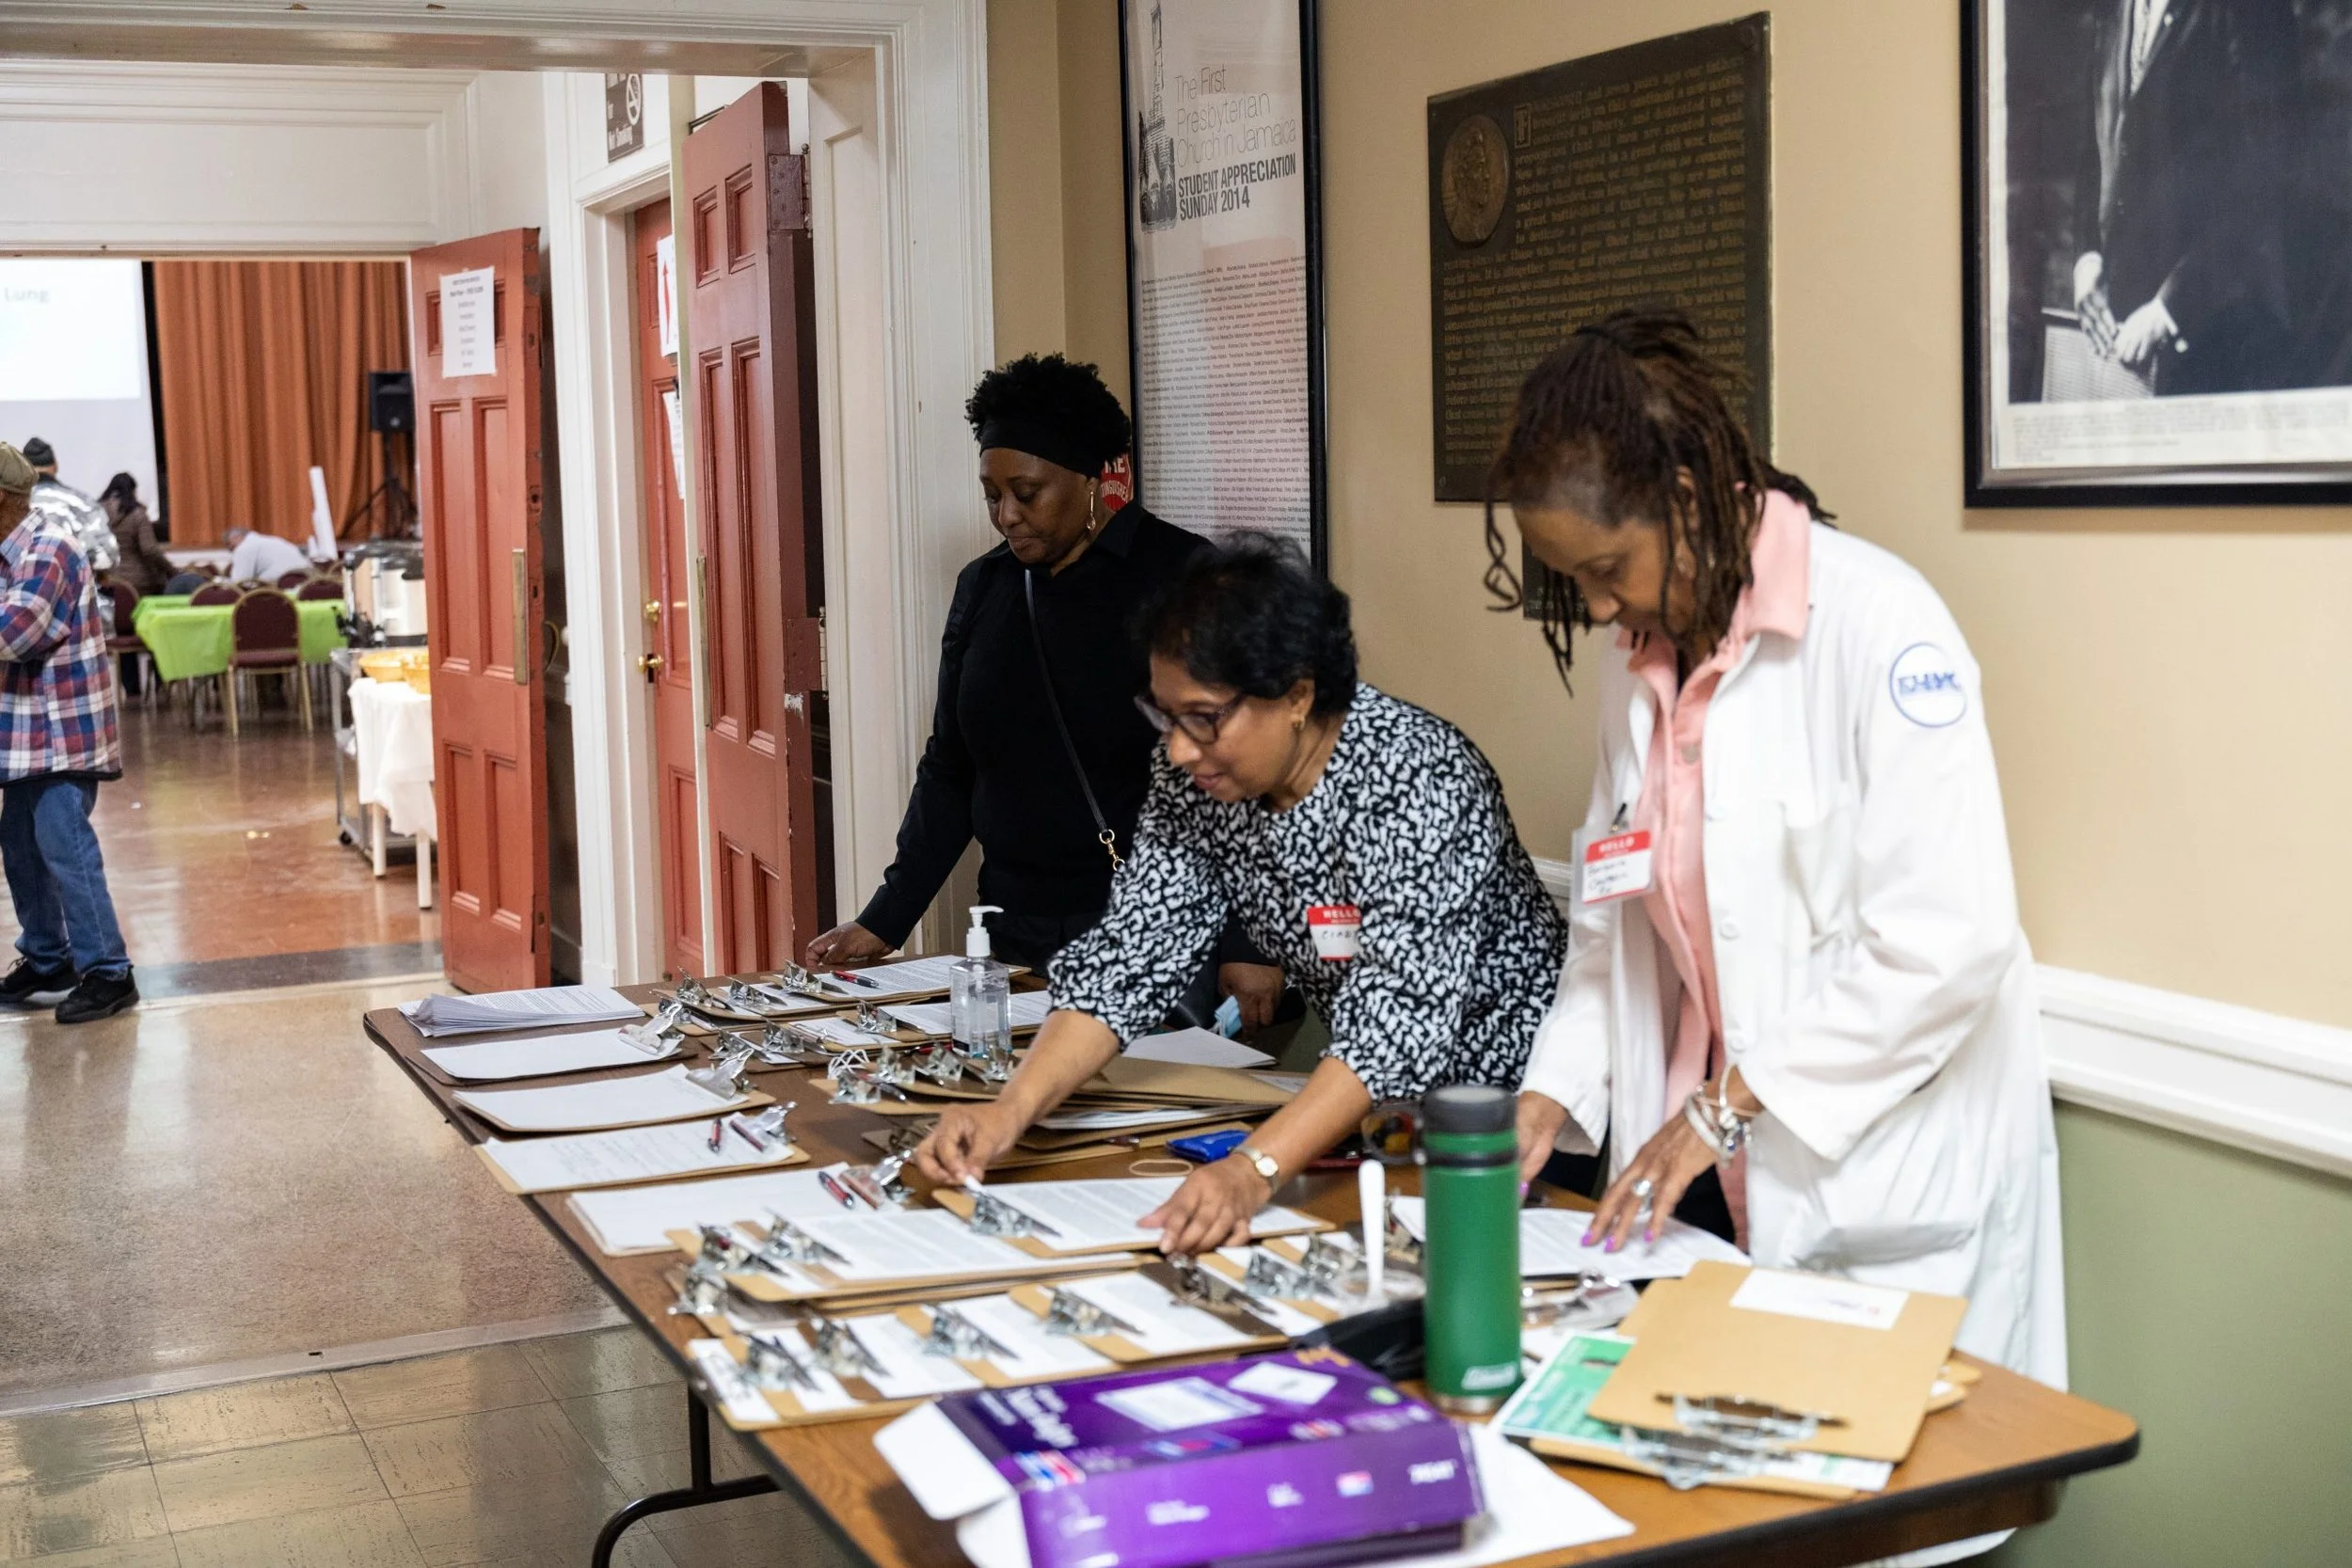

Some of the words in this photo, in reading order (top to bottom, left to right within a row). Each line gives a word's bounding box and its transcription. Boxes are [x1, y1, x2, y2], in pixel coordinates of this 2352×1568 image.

[1176, 75, 1197, 102] The
[1201, 64, 1227, 95] First
[1177, 92, 1270, 135] Presbyterian
[1178, 133, 1219, 167] Church
[1221, 133, 1232, 155] in
[1237, 119, 1296, 153] Jamaica
[1178, 170, 1218, 198] STUDENT
[1221, 152, 1296, 188] APPRECIATION
[1180, 196, 1218, 221] SUNDAY
[1221, 186, 1250, 213] 2014
